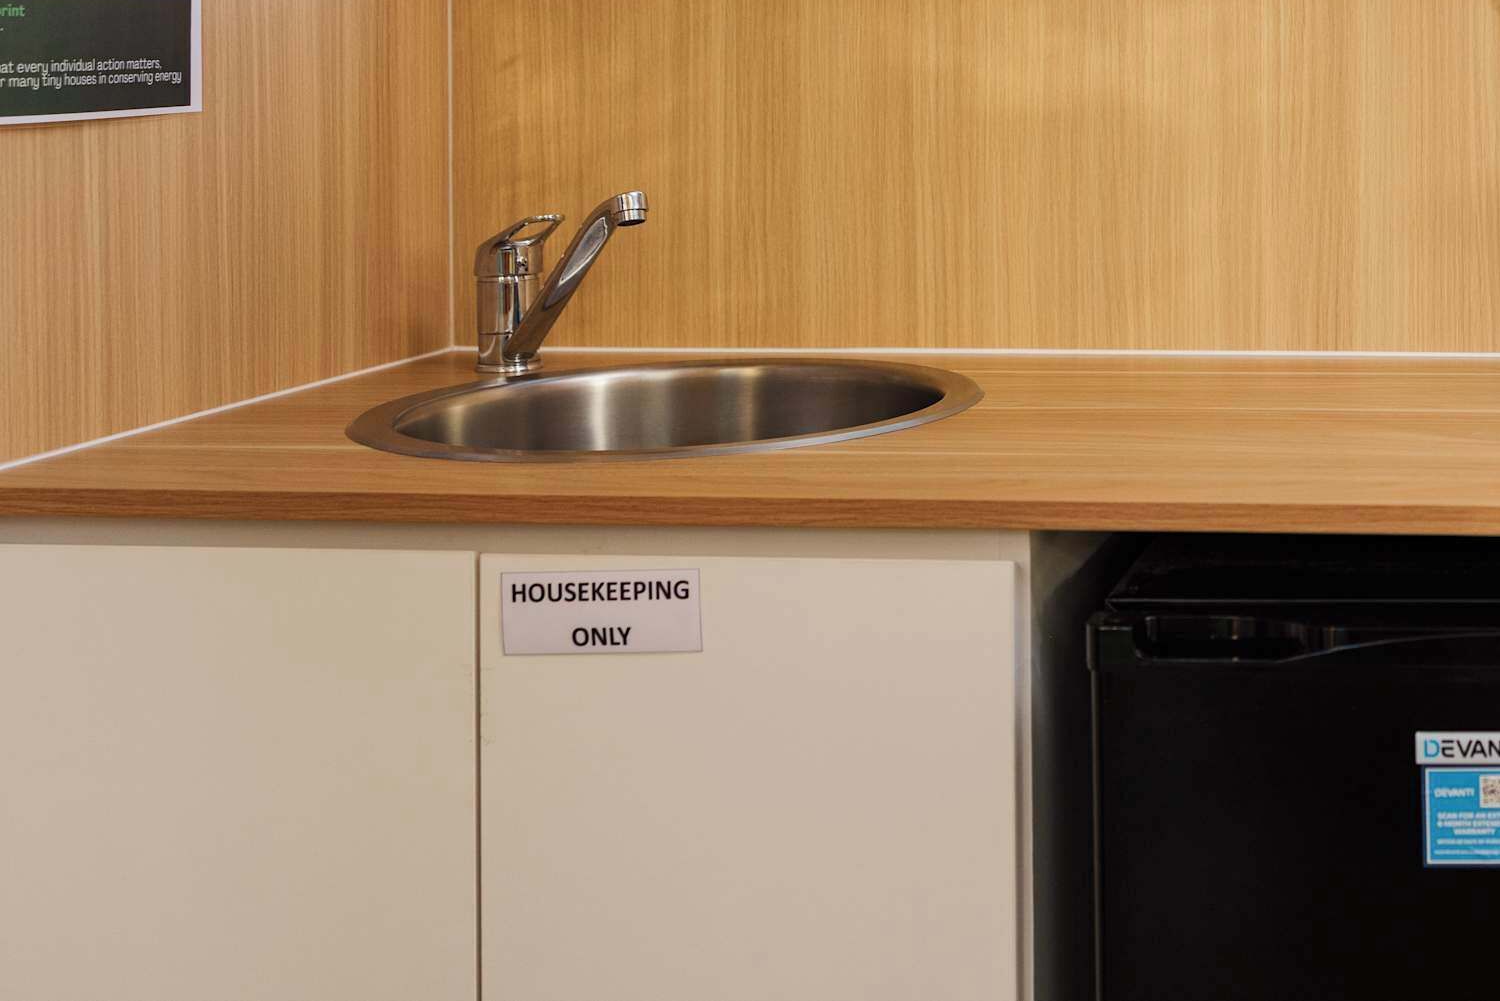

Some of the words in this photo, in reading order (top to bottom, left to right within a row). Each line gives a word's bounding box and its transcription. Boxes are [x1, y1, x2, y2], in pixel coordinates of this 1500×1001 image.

[16, 62, 48, 76] every
[51, 58, 95, 73] individual
[97, 58, 125, 70] action
[126, 57, 162, 70] matters,
[8, 77, 40, 90] many
[42, 73, 61, 89] tiny
[64, 73, 97, 86] houses
[99, 72, 107, 84] in
[108, 70, 153, 85] conserving
[154, 70, 182, 85] energy
[511, 580, 690, 603] HOUSEKEEPING
[571, 626, 631, 647] ONLY
